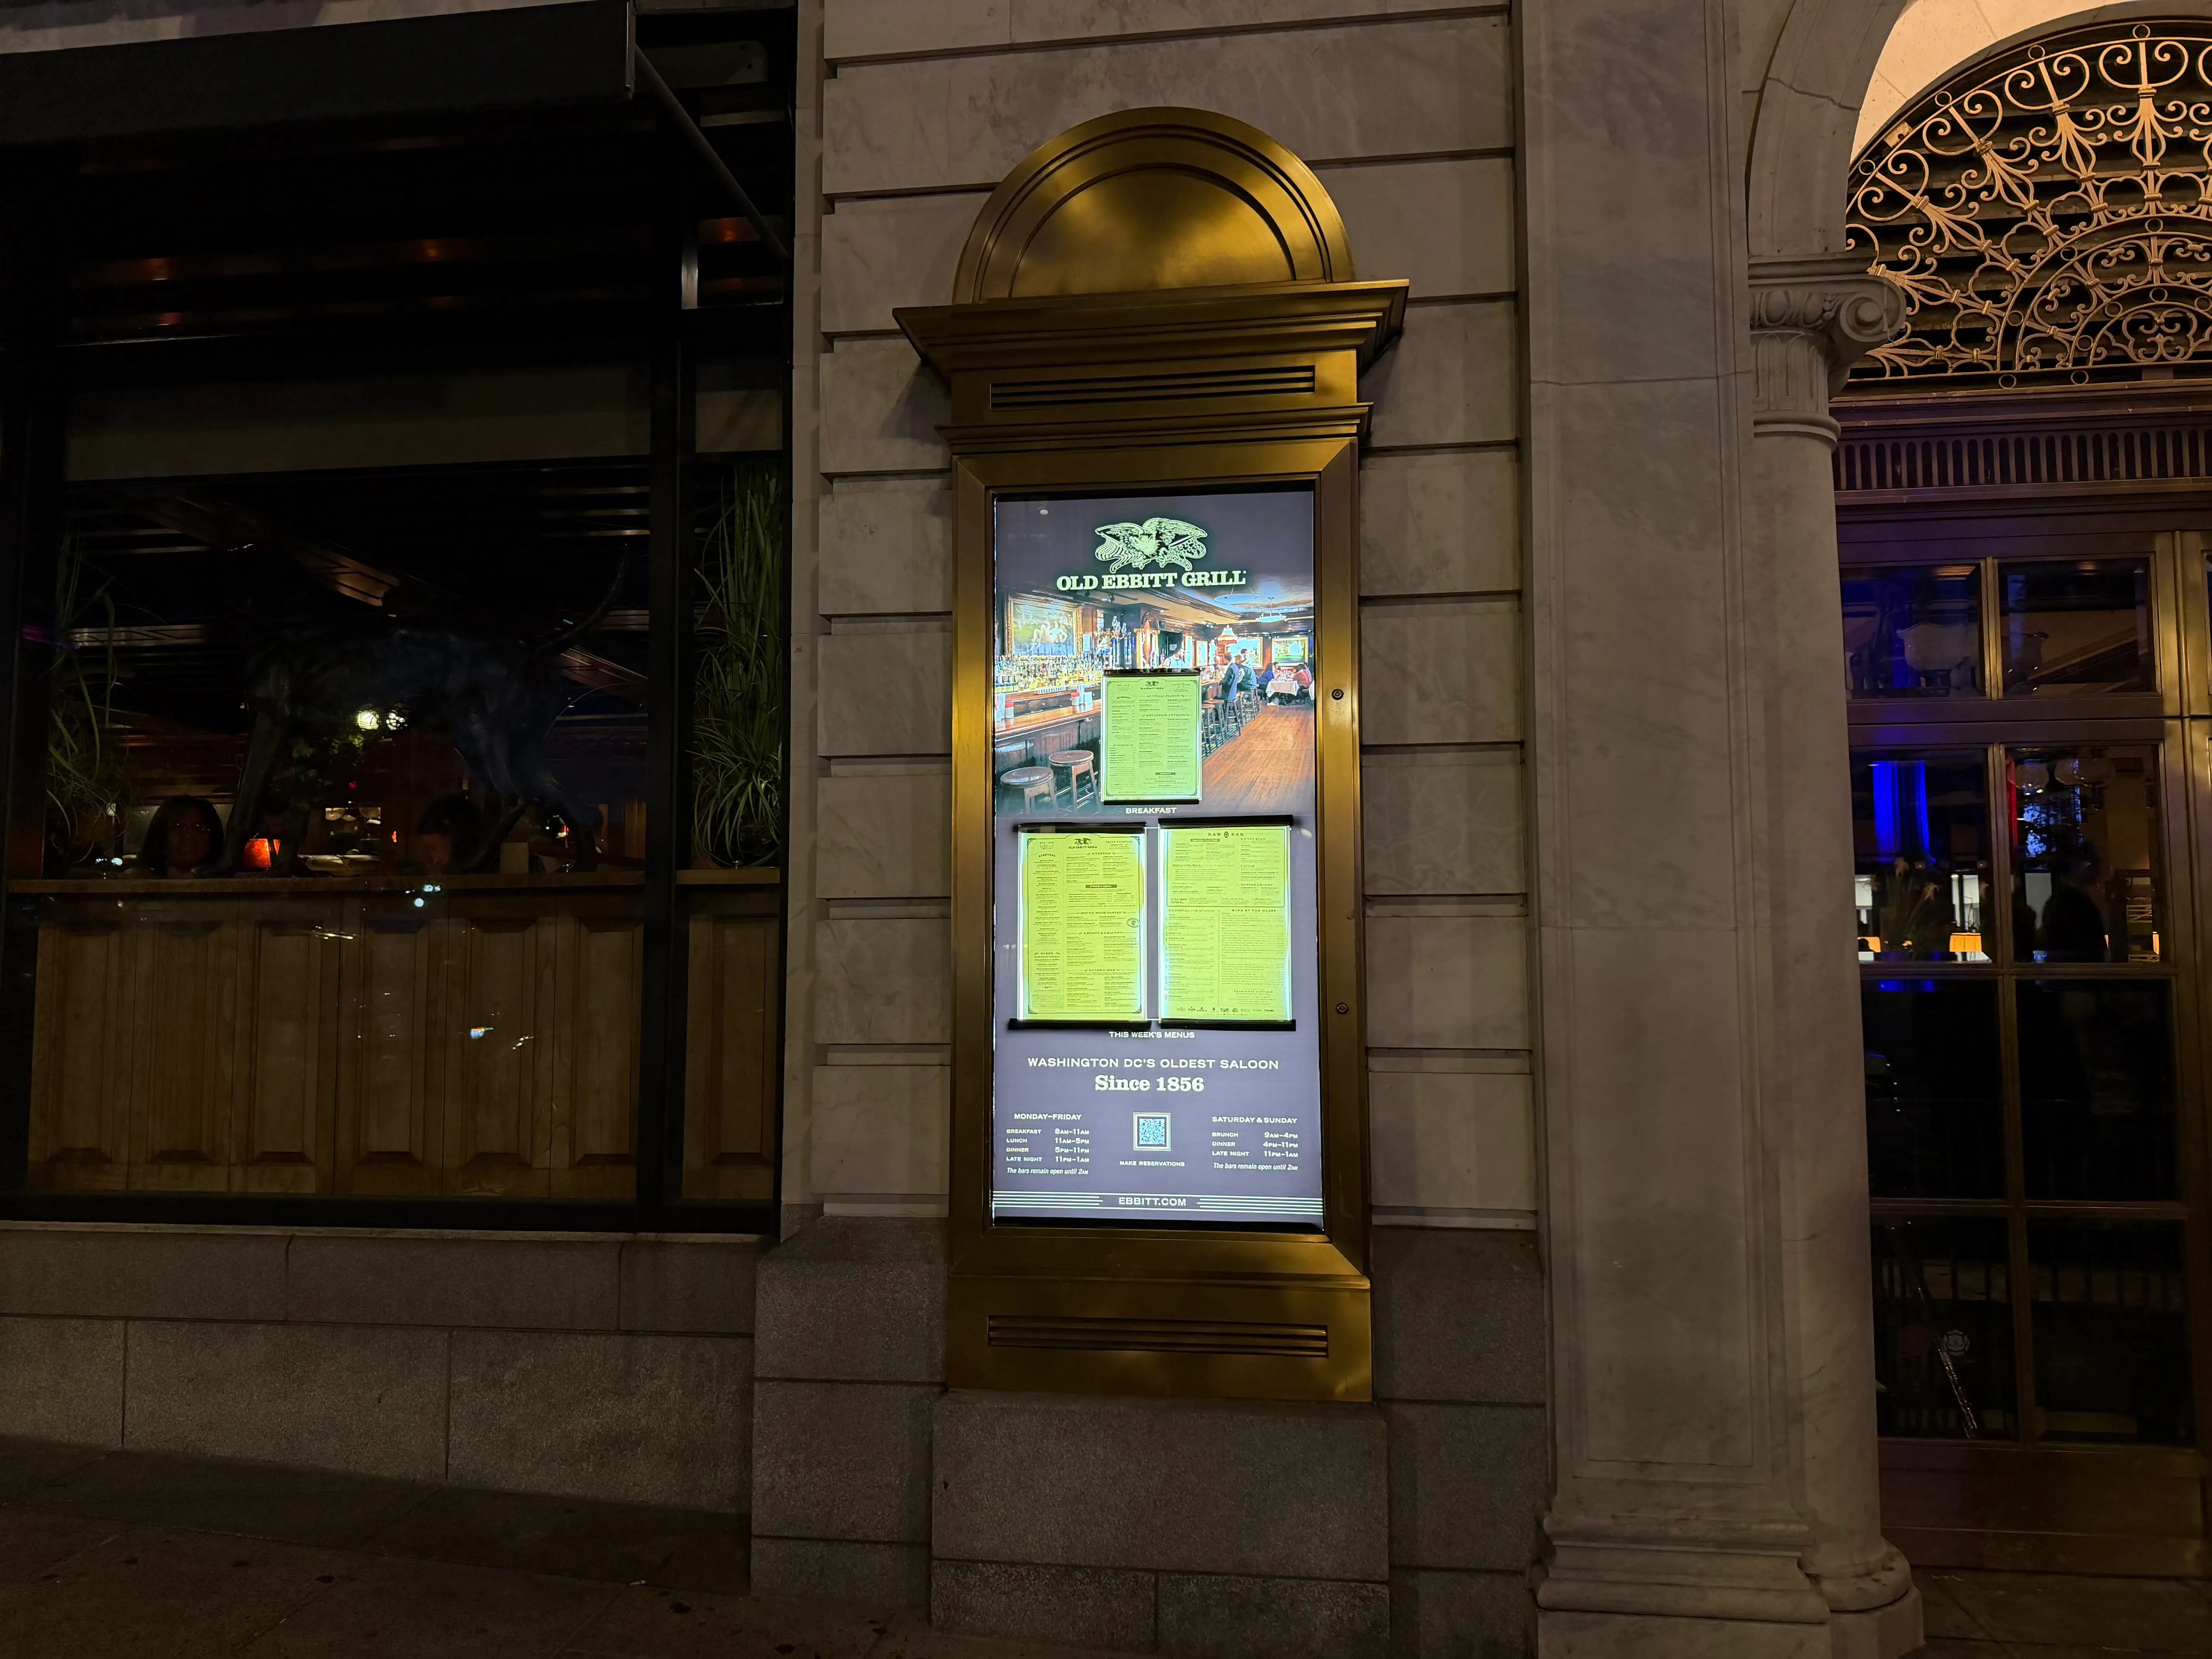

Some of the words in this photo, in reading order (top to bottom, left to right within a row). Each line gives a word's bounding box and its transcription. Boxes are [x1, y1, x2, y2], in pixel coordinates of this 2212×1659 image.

[1056, 575, 1098, 591] OLD
[1102, 573, 1178, 589] EBBITT
[1182, 570, 1246, 587] GRILL
[1027, 1058, 1118, 1067] WASHINGTON
[1124, 1058, 1156, 1068] DC'S
[1160, 1059, 1216, 1068] OLDEST
[1220, 1060, 1278, 1069] SALOON
[1095, 1075, 1151, 1091] Since
[1156, 1077, 1204, 1092] 1856
[1119, 1197, 1186, 1206] EBBITT.COM
